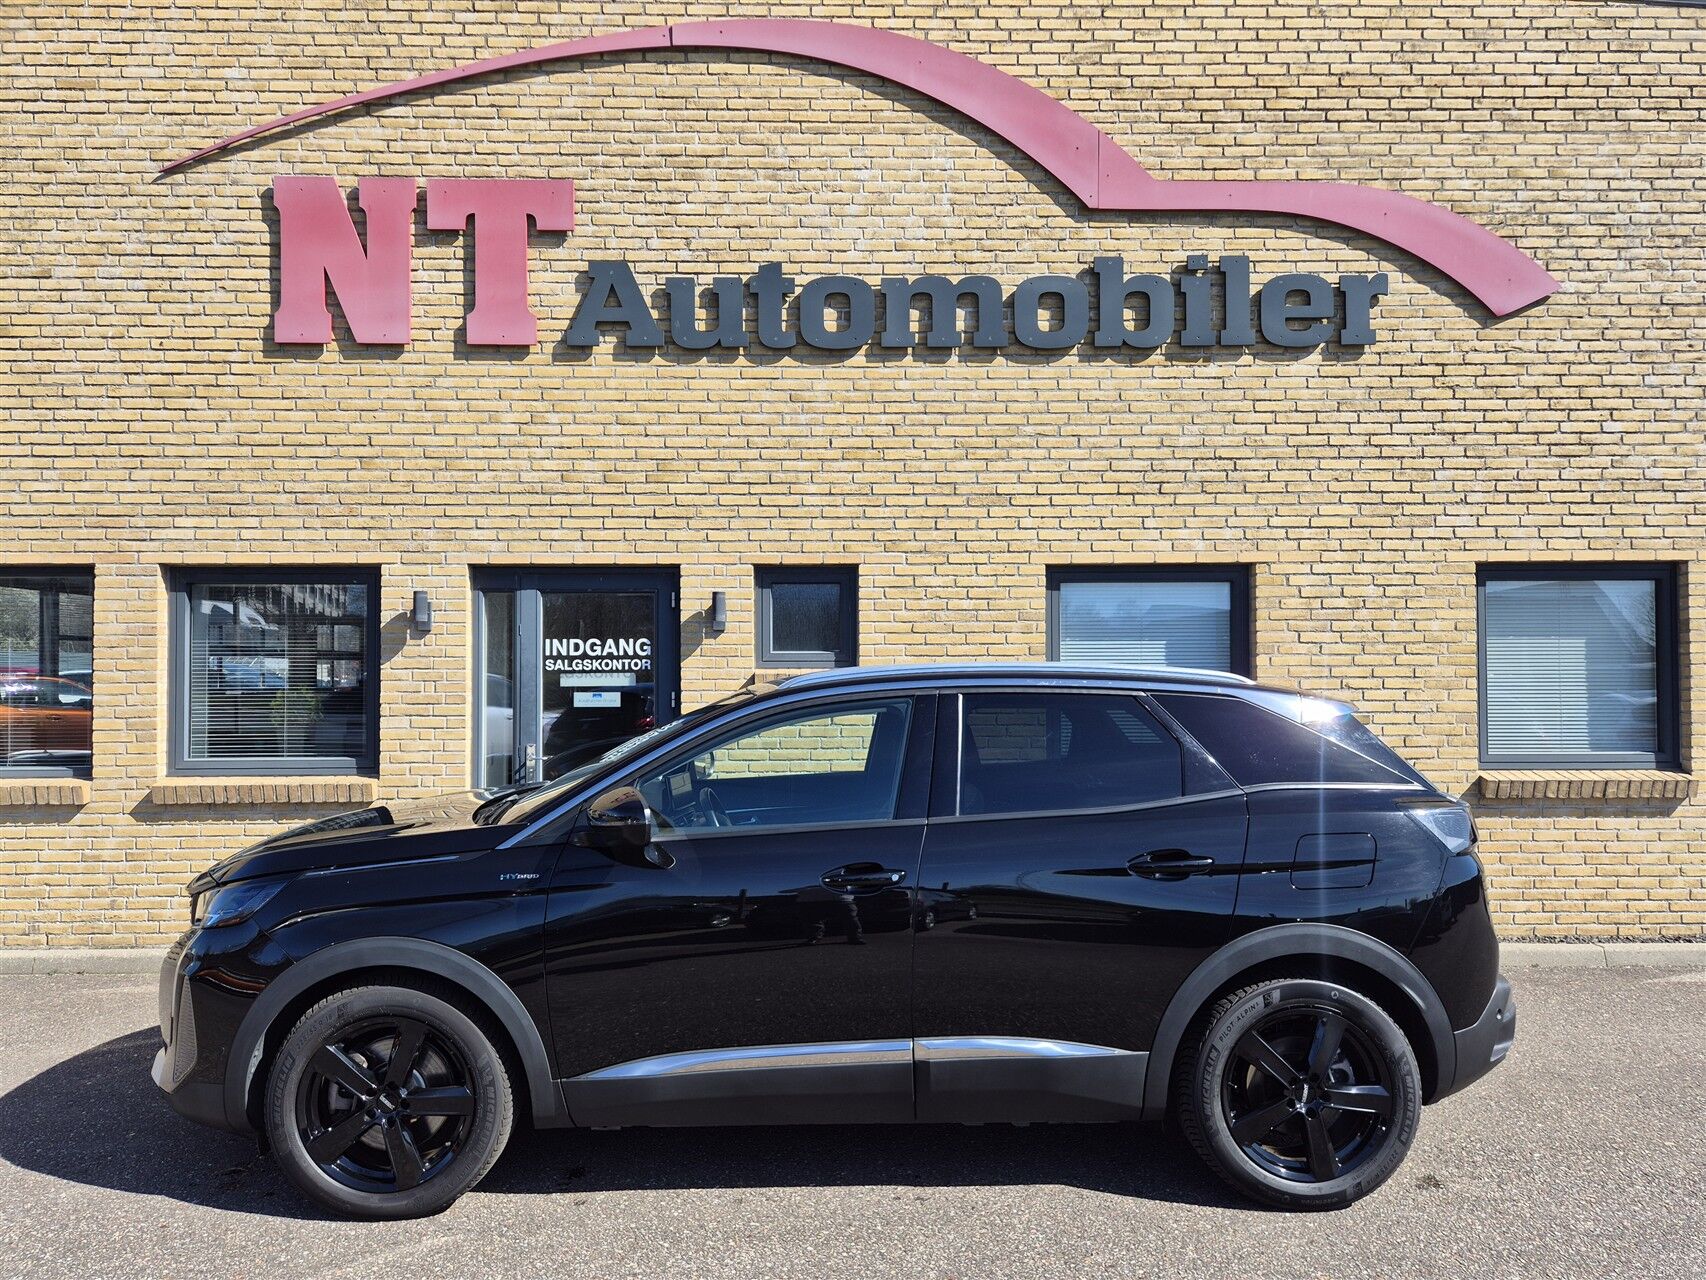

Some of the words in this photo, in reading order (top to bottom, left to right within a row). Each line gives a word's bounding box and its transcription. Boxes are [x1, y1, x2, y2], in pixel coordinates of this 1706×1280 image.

[273, 176, 575, 345] NT
[566, 255, 1389, 350] Automobiler
[545, 638, 651, 656] INDGANG
[545, 659, 651, 671] SALGSKONTOR
[500, 873, 540, 881] HYBRID
[1218, 1022, 1235, 1043] PILOT
[1203, 1046, 1220, 1117] MICHELIN
[1400, 1075, 1416, 1143] MICHELIN
